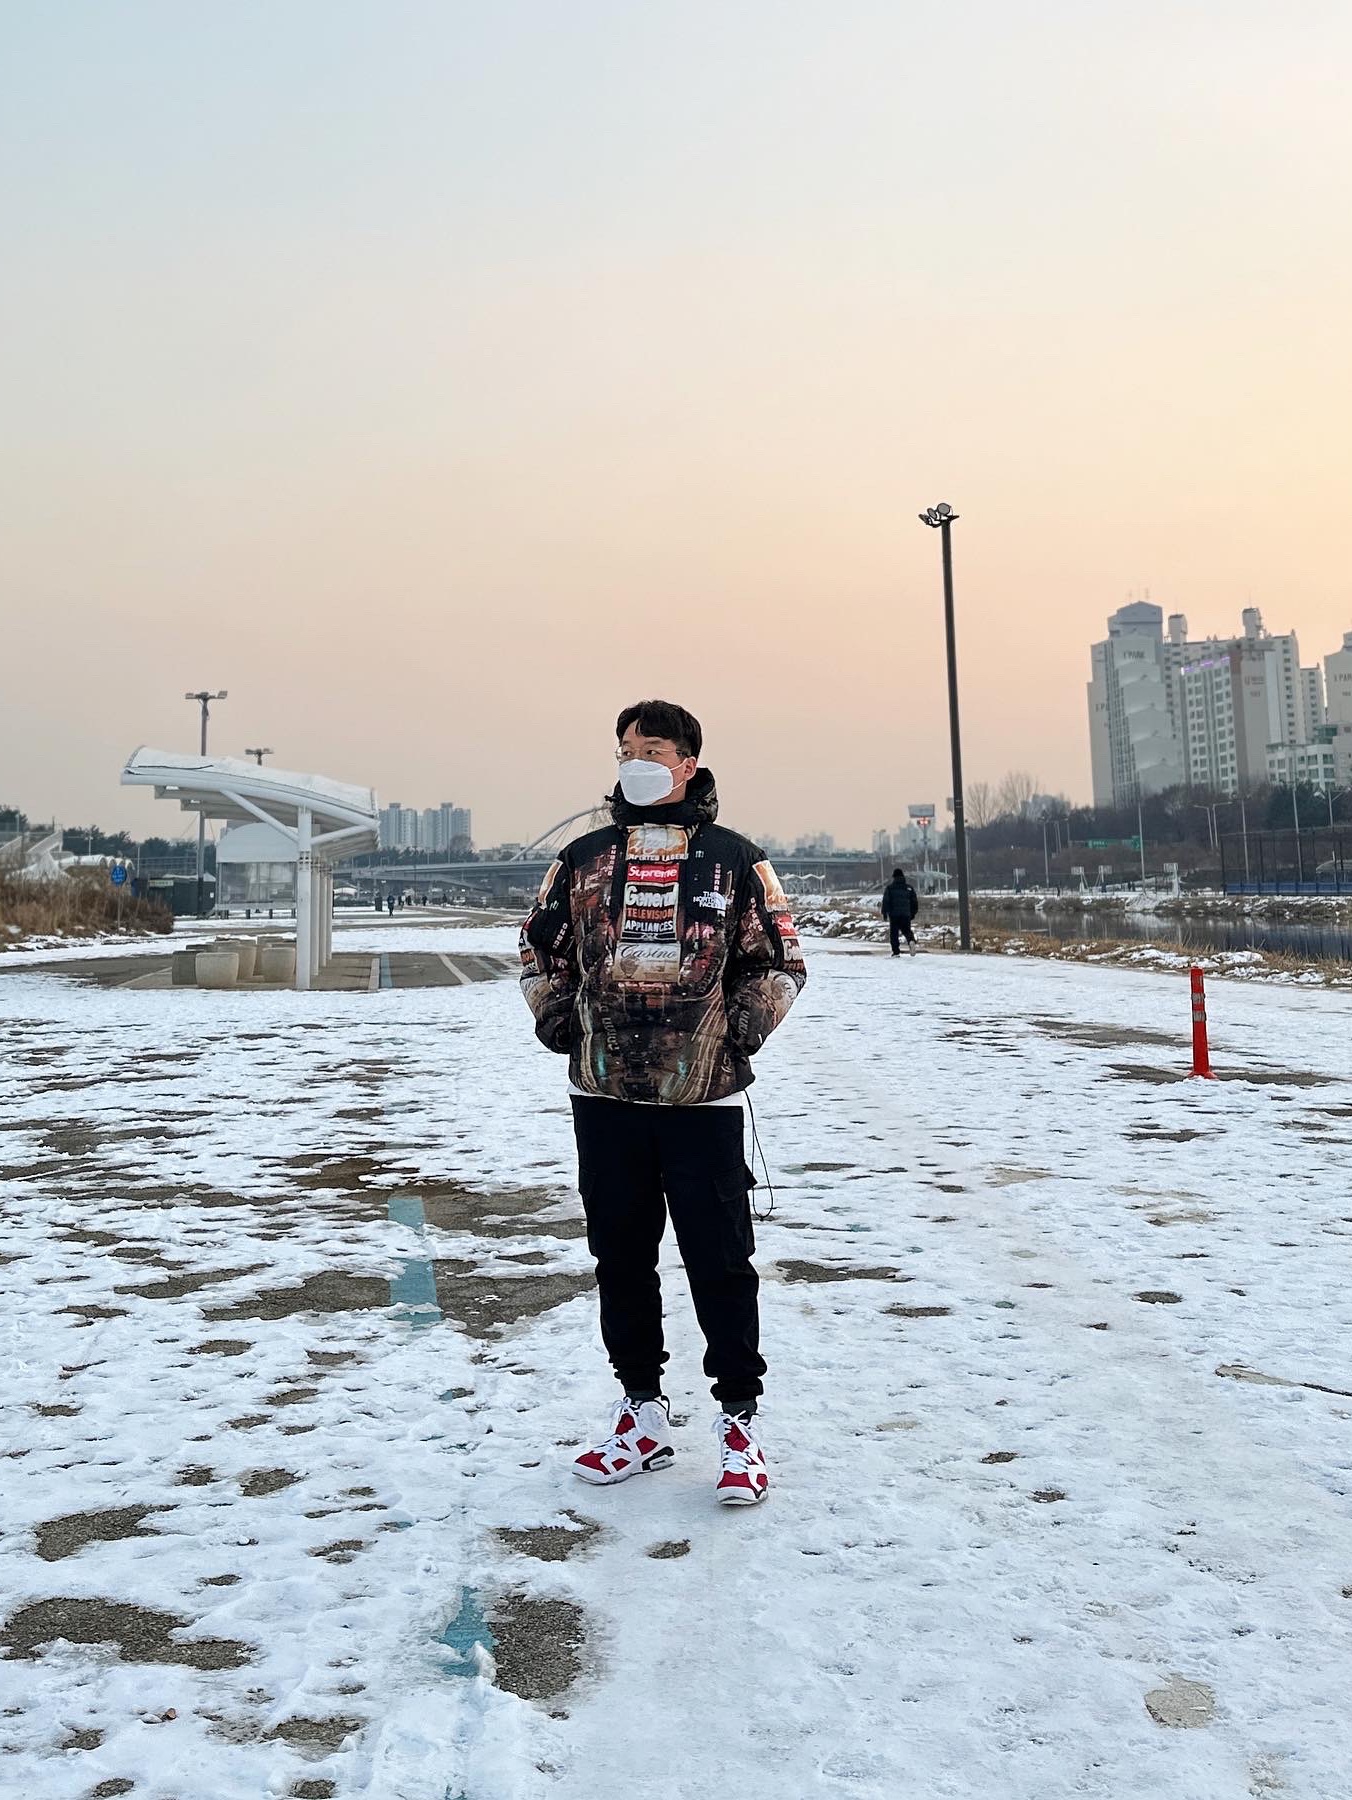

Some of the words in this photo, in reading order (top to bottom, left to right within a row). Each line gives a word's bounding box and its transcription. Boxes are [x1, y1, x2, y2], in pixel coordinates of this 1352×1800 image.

[628, 866, 677, 879] Supreme
[625, 885, 678, 907] General
[627, 907, 673, 920] TELEVISION
[625, 920, 673, 932] APPLIANCES
[621, 944, 677, 959] Casino
